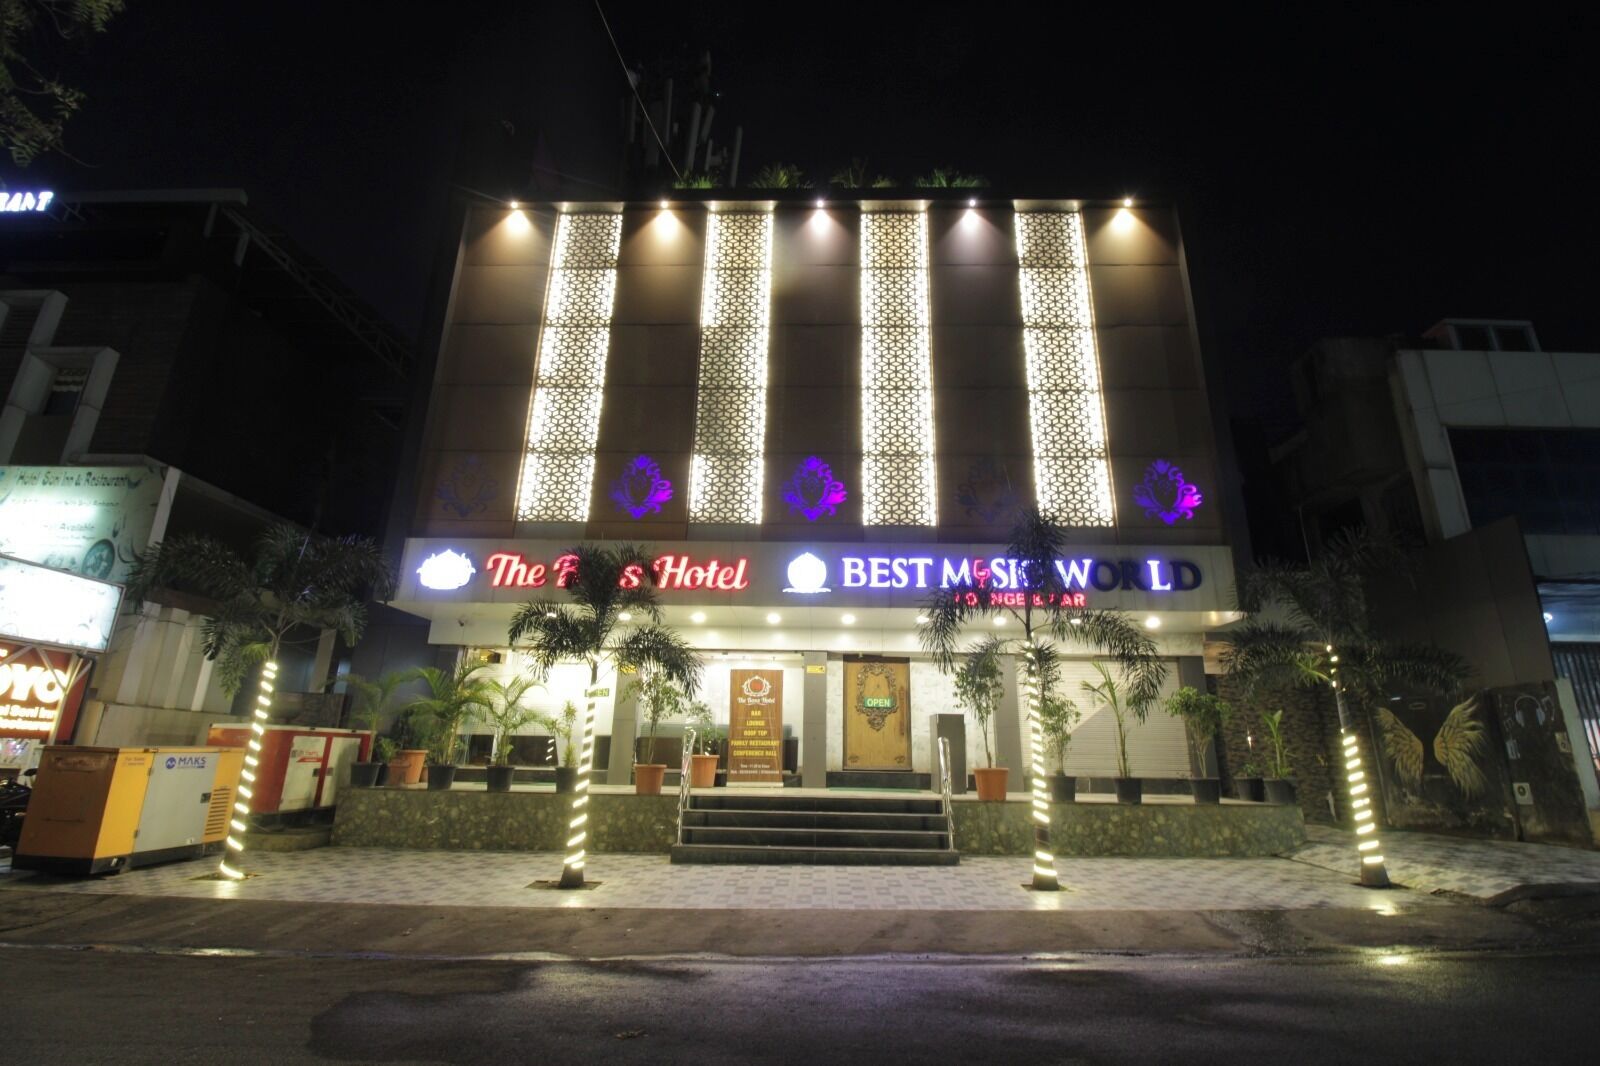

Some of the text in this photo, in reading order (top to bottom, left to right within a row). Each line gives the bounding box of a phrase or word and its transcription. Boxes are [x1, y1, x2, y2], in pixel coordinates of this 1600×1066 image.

[487, 553, 547, 590] The
[653, 555, 749, 590] Hotel
[841, 557, 933, 588] BEST
[1054, 558, 1202, 592] WORLD
[954, 592, 1025, 607] ONGE
[1048, 592, 1087, 607] AR
[866, 698, 890, 707] OPEN
[178, 757, 206, 765] MAKS
